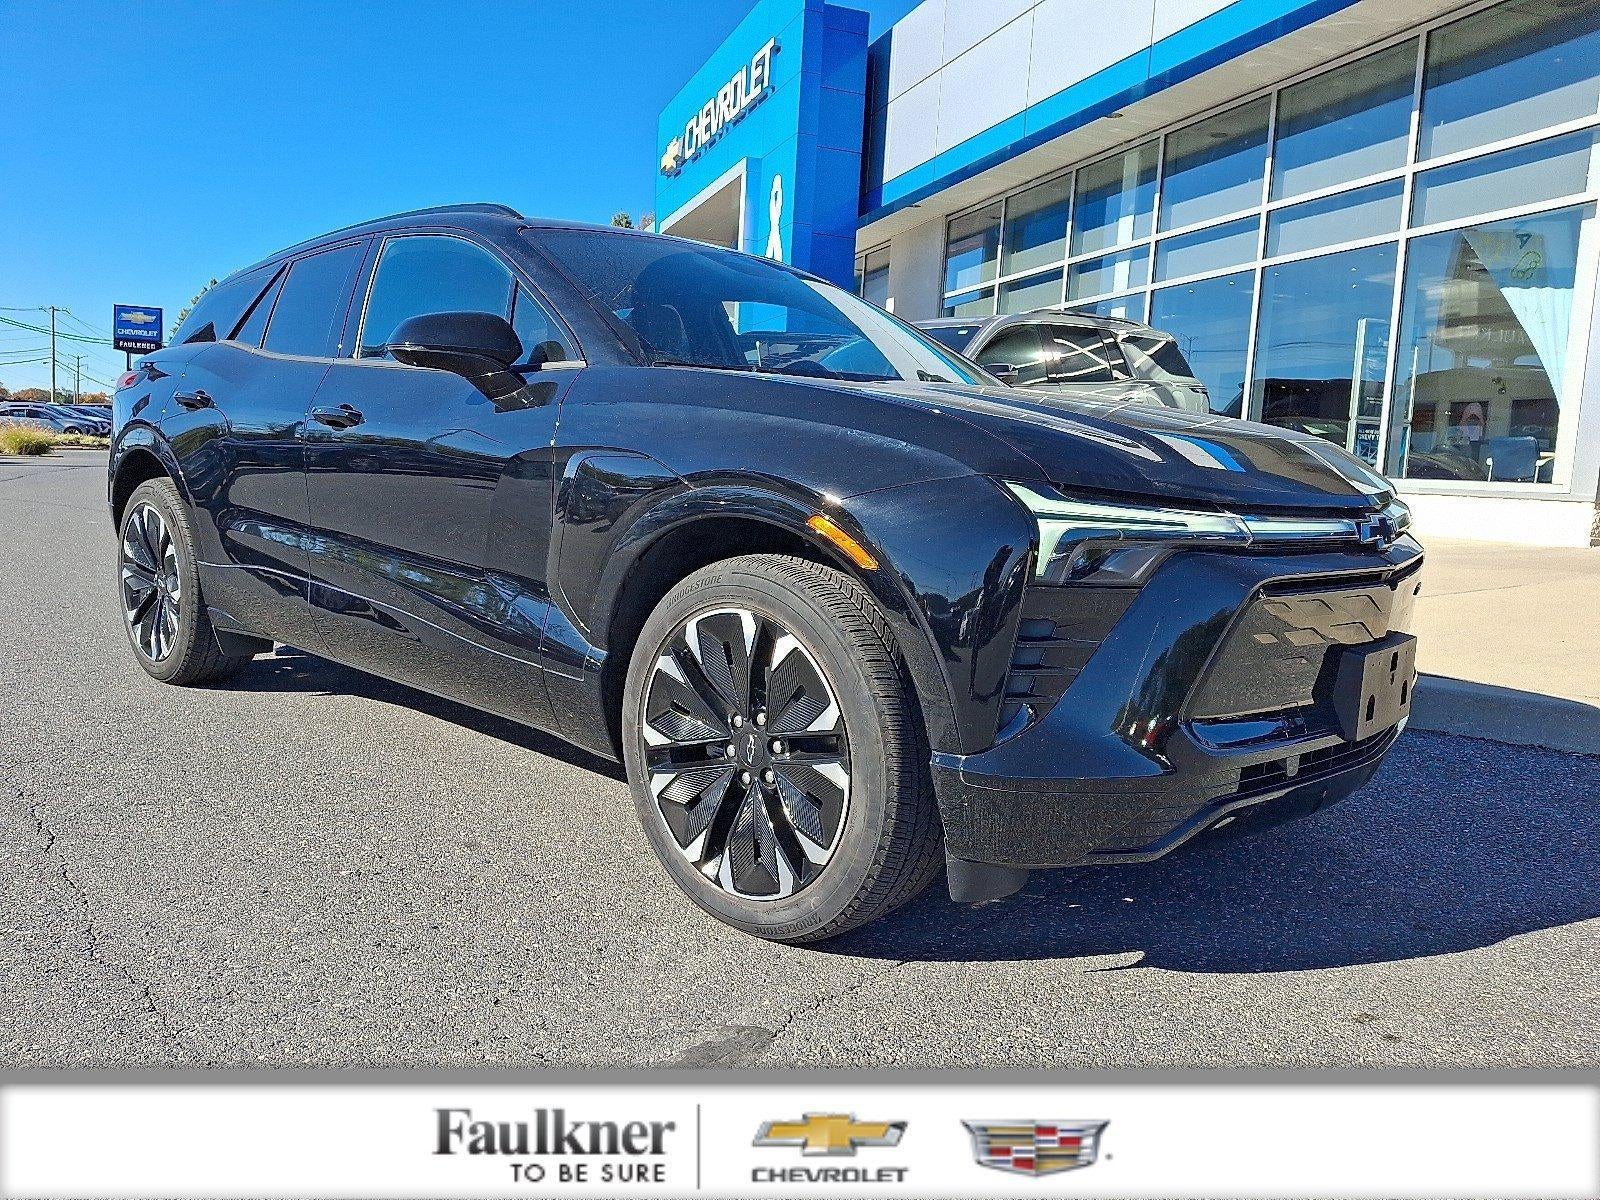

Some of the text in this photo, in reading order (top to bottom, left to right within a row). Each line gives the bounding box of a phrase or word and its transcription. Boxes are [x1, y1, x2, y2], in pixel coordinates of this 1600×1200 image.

[685, 37, 774, 159] CHEVROLET
[117, 328, 158, 336] CHEVROLET
[119, 341, 156, 349] FAULKNER
